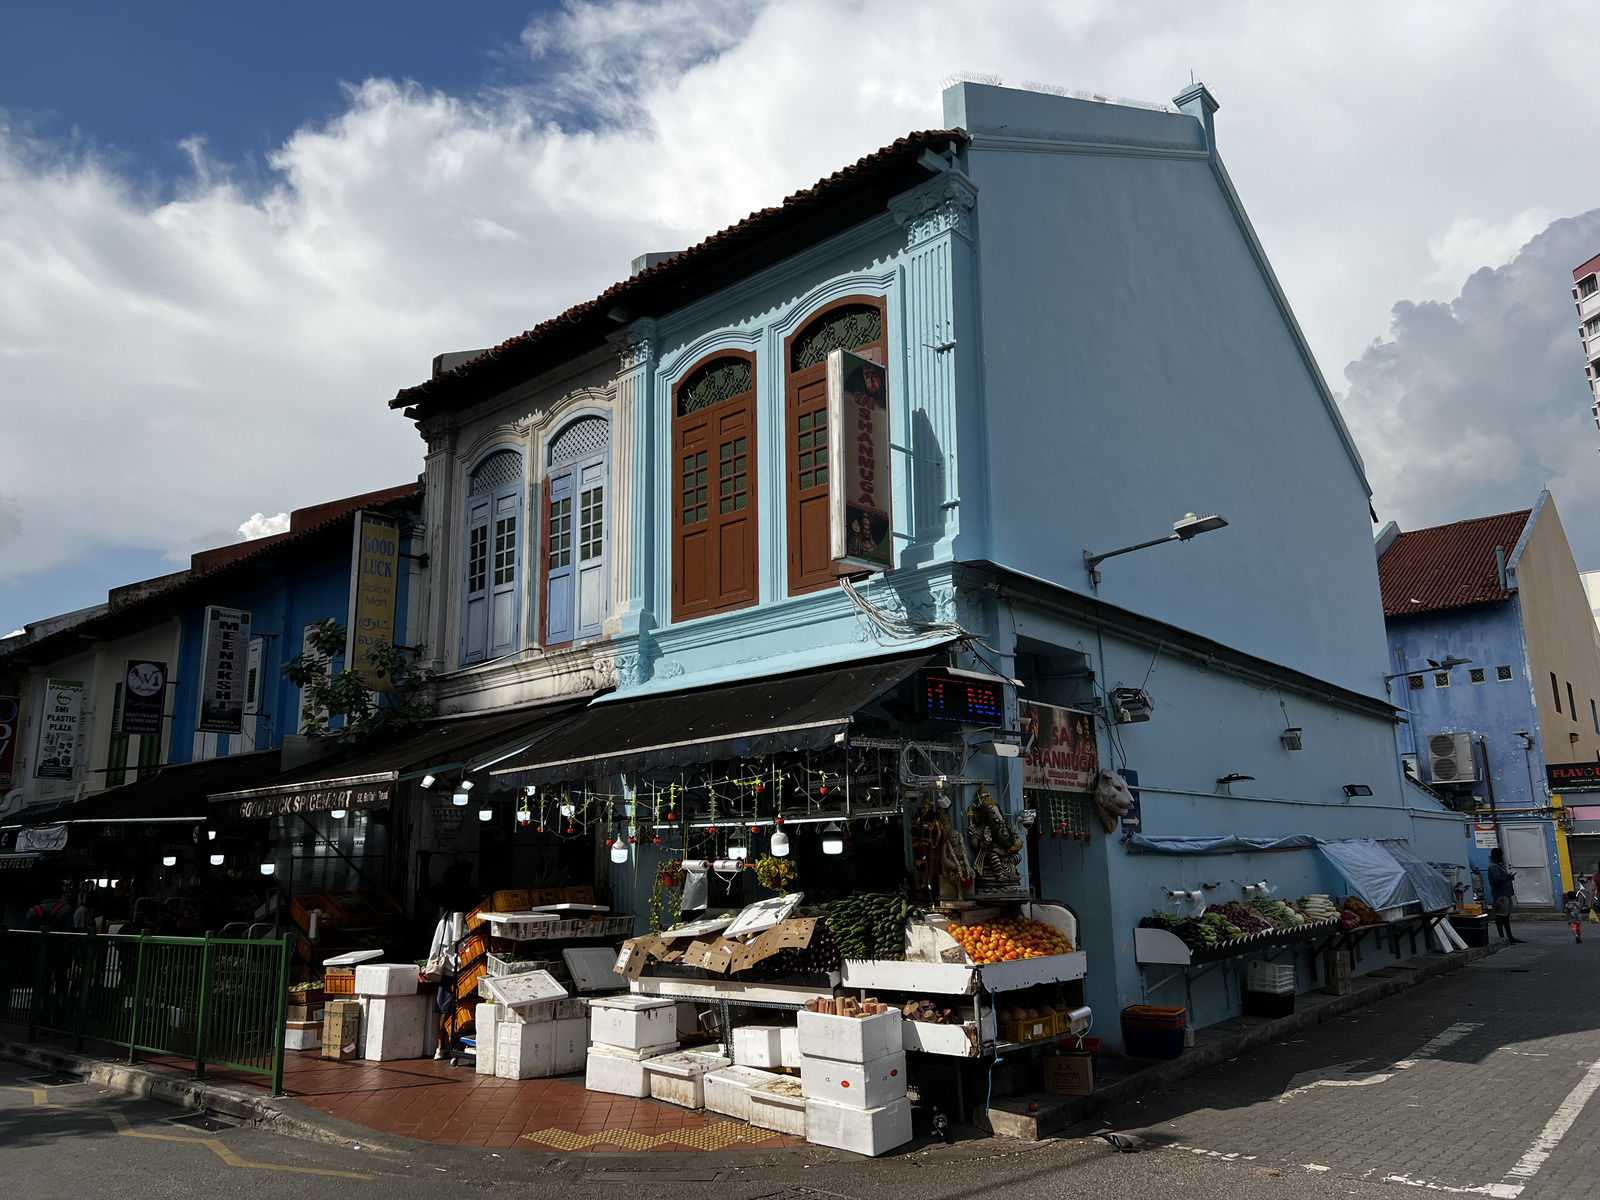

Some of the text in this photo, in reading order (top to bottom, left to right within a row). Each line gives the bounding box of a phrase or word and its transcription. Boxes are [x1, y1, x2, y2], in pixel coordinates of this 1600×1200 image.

[854, 391, 875, 411] SAI
[856, 407, 875, 508] SHANMUGA
[363, 535, 396, 557] GOOD
[363, 557, 393, 579] LUCK
[363, 582, 391, 596] Spice
[365, 596, 388, 607] Mart
[216, 620, 239, 710] MEENAKSHI
[47, 714, 77, 724] PLASTIC
[55, 705, 69, 714] SMI
[49, 723, 72, 733] PLAZA
[1051, 724, 1075, 748] SAI
[239, 802, 264, 818] GOOD
[266, 797, 292, 816] LUCK
